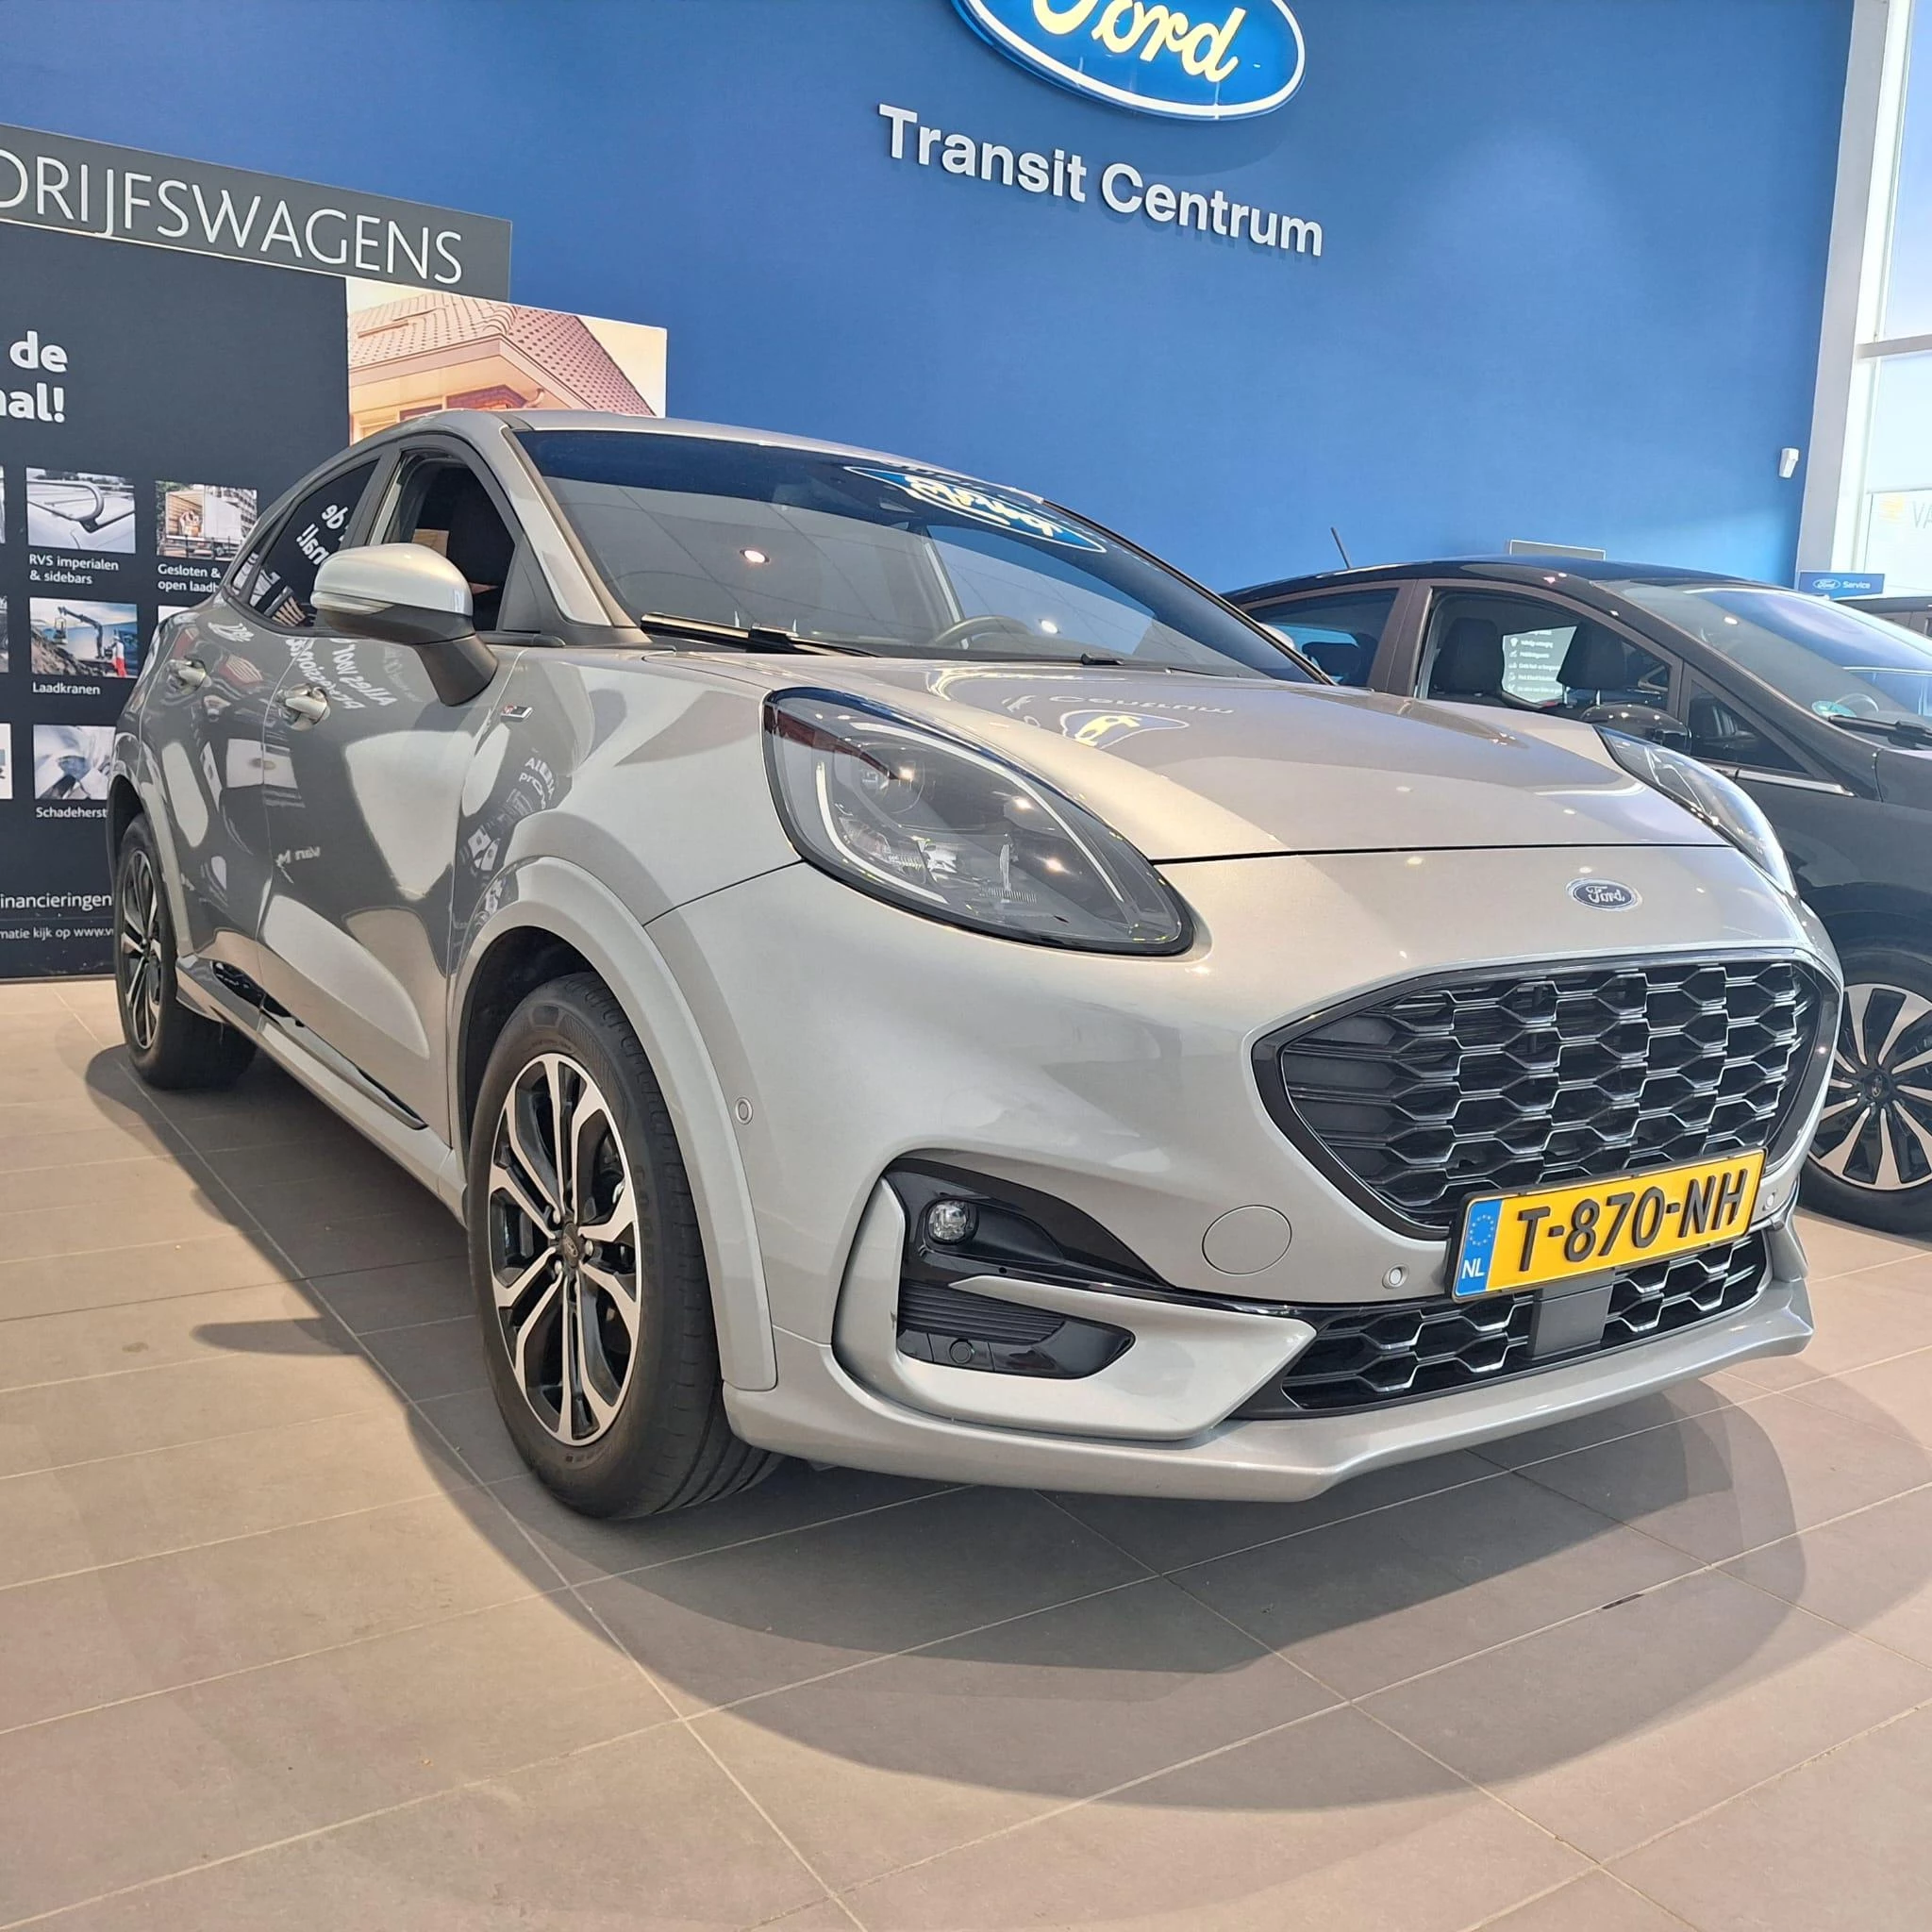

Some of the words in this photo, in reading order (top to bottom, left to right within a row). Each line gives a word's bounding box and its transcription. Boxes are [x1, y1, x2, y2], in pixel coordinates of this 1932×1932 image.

[878, 103, 1087, 203] Transit
[1101, 162, 1324, 257] Centrum
[9, 330, 69, 373] de
[0, 382, 66, 424] al!
[29, 554, 54, 566] RVS
[57, 555, 119, 571] imperialen
[158, 563, 208, 577] Gesloten
[210, 568, 222, 579] &
[29, 570, 41, 581] &
[43, 571, 92, 585] sidebars
[158, 580, 187, 592] open
[1842, 580, 1871, 590] Service
[32, 681, 101, 695] Laadkranen
[0, 891, 112, 912] inancieringen
[1585, 885, 1625, 903] Ford
[33, 926, 53, 941] kijk
[56, 928, 72, 941] op
[1517, 1168, 1749, 1272] T-870-NH
[1461, 1258, 1485, 1279] NL
